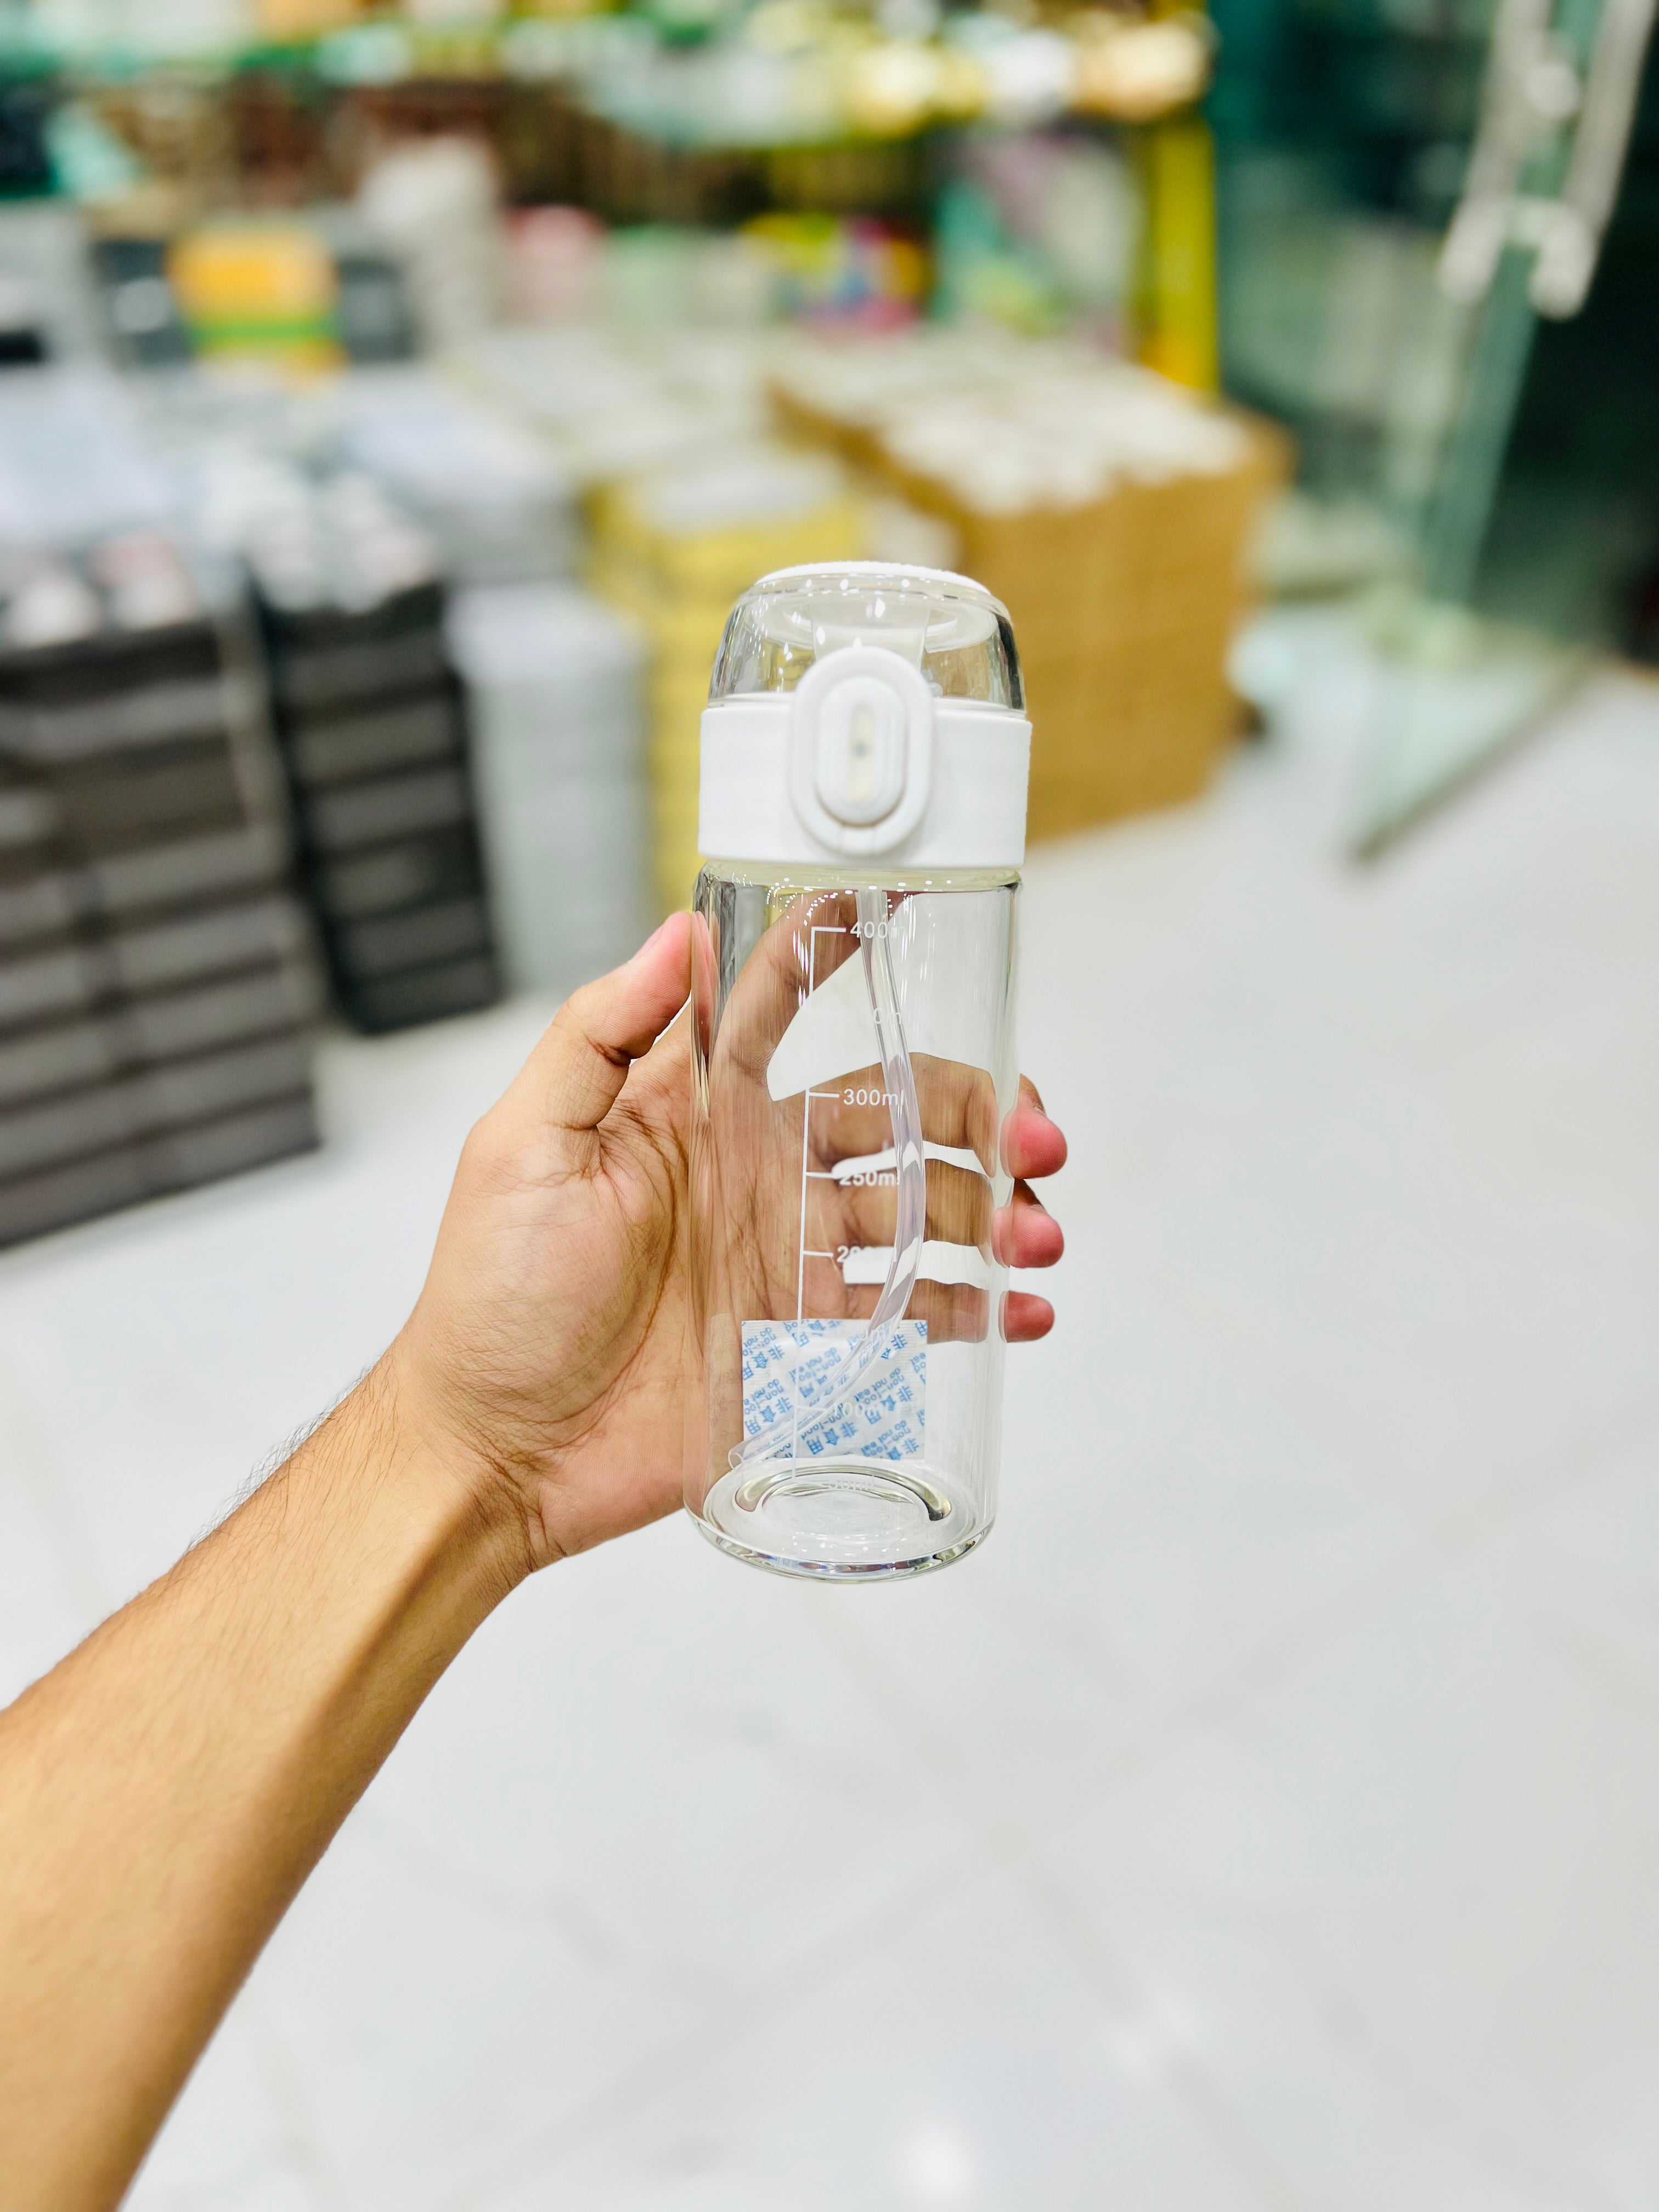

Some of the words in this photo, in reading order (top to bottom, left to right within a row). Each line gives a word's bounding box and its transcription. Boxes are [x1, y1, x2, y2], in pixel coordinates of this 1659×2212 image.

[843, 1088, 904, 1106] 300ml
[744, 1386, 784, 1415] non-foo
[861, 1375, 905, 1407] non-foo
[745, 1397, 792, 1435] 非食用
[806, 1413, 856, 1454] 非食用
